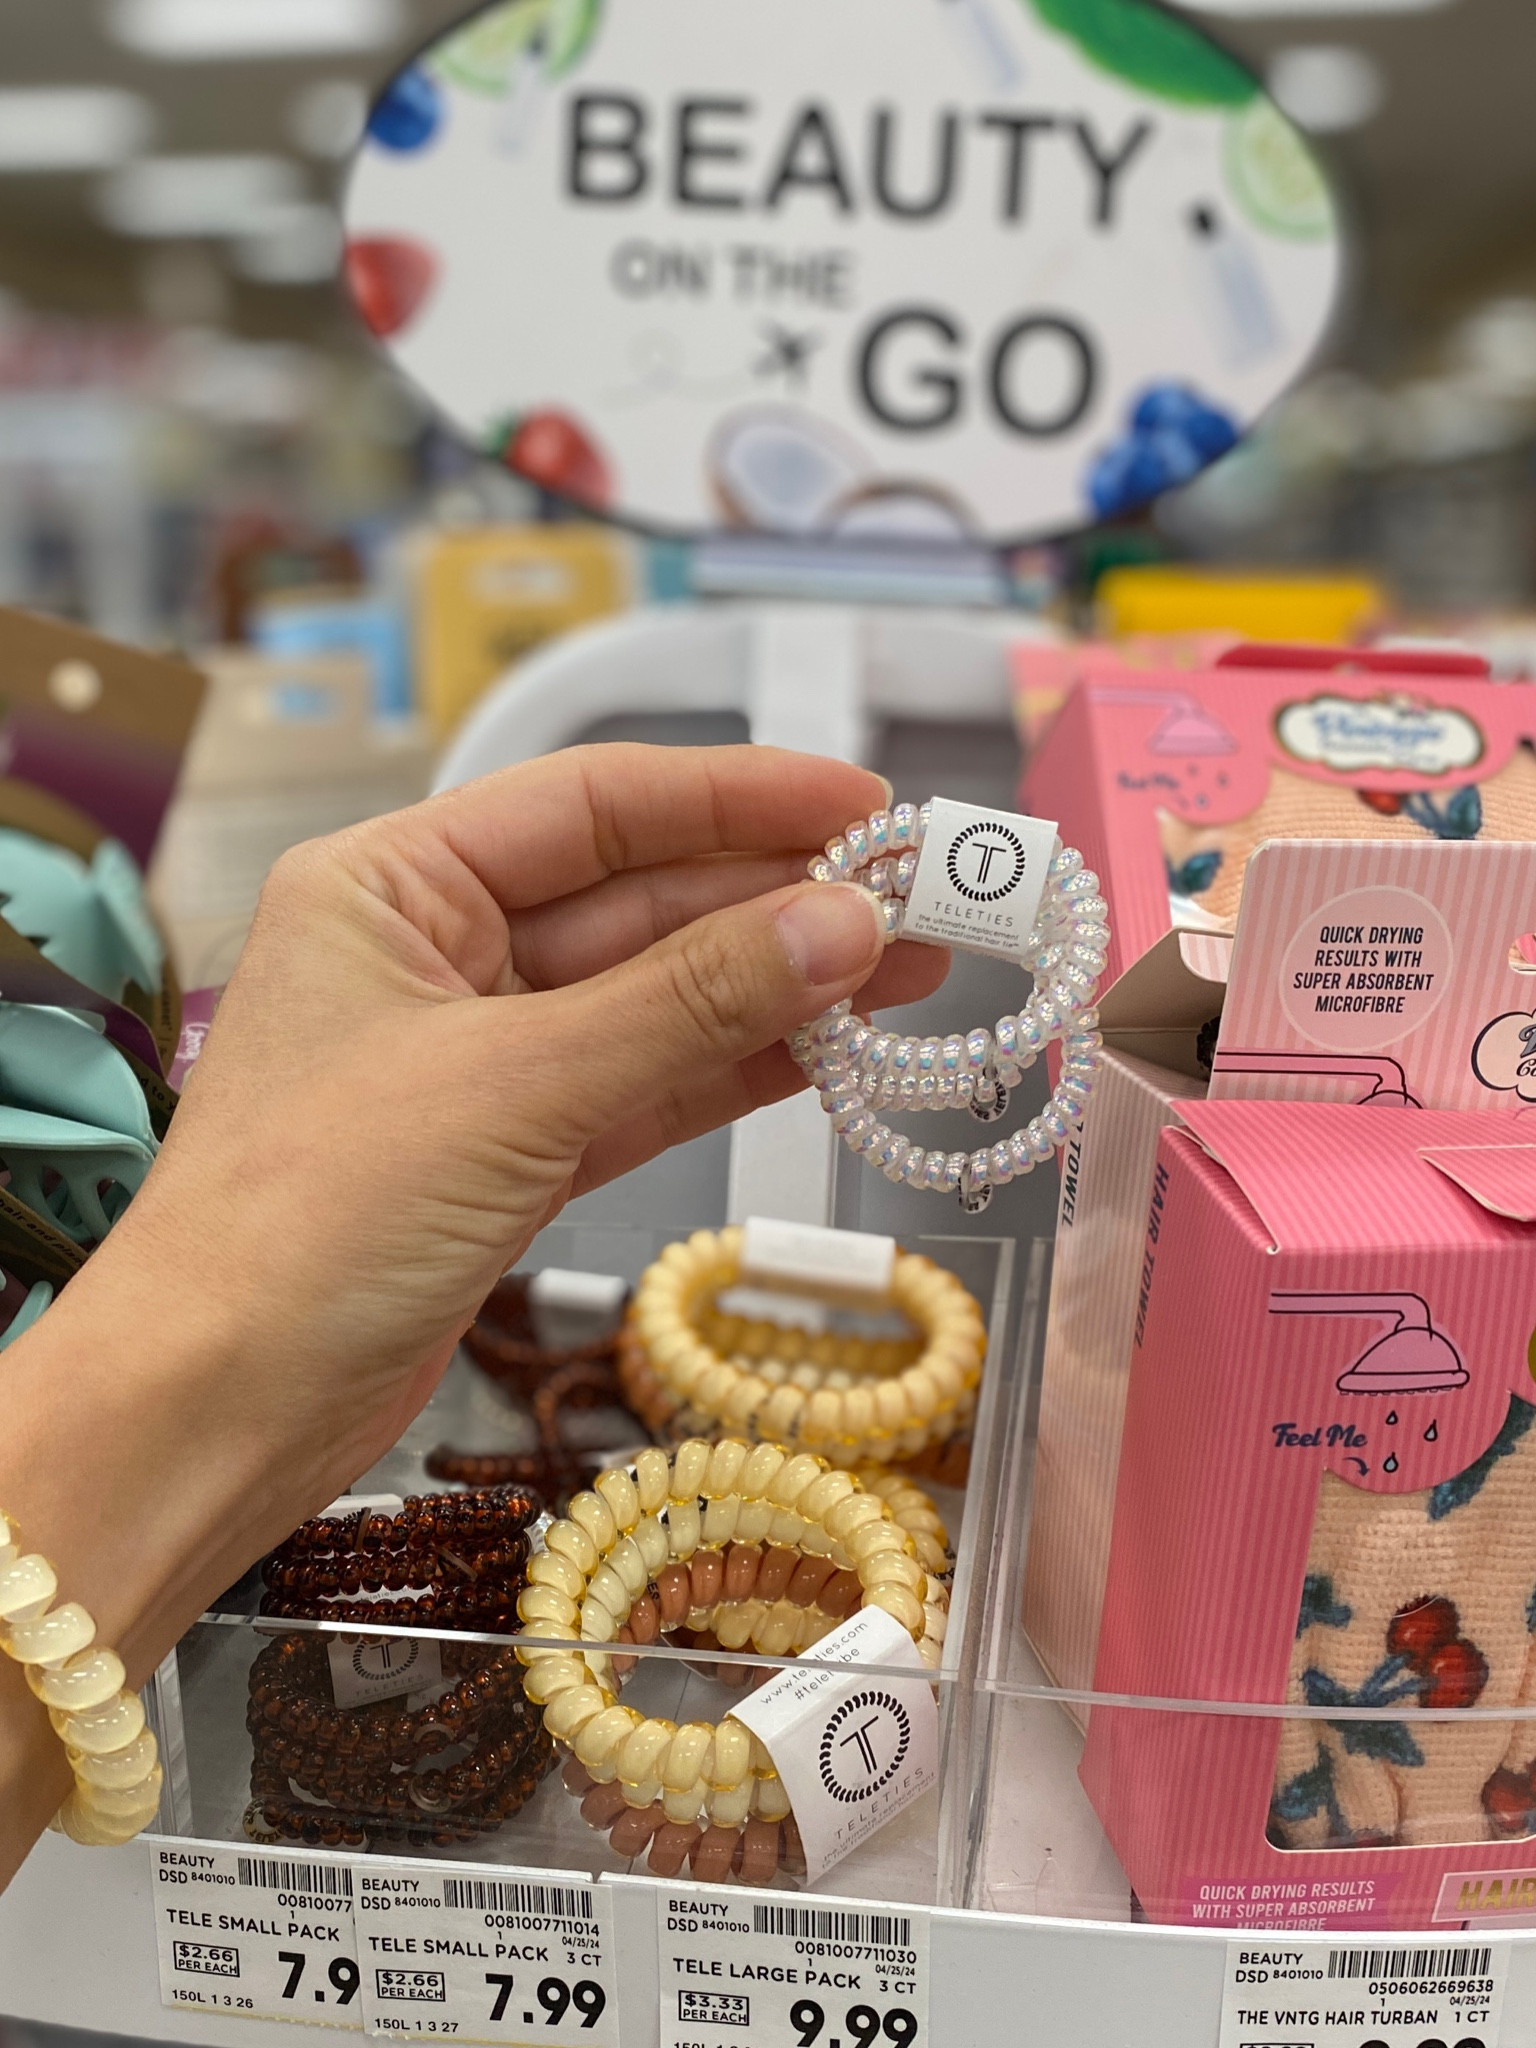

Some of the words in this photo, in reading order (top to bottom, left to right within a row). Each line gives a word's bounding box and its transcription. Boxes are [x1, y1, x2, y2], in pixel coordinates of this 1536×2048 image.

[564, 92, 1151, 226] BEAUTY
[610, 238, 711, 297] ON
[727, 243, 853, 308] THE
[856, 306, 1100, 437] GO
[934, 901, 1014, 928] TELETIES
[915, 922, 923, 930] to
[926, 924, 939, 933] the
[941, 926, 983, 943] traditional
[984, 935, 1000, 946] hair
[918, 914, 931, 924] the
[933, 916, 966, 931] ultimate
[968, 925, 1020, 941] replacement
[1320, 926, 1364, 944] QUICK
[1368, 927, 1424, 944] DRYING
[1315, 950, 1379, 967] RESULTS
[1385, 951, 1422, 968] WITH
[1293, 973, 1341, 989] SUPER
[1346, 974, 1434, 991] ABSORBENT
[1315, 996, 1405, 1013] MICROFIBRE
[1062, 1139, 1082, 1228] TOWEL
[1148, 1162, 1170, 1245] HAIR
[1134, 1251, 1156, 1349] TOWEL
[1272, 1422, 1322, 1447] Feel
[1326, 1424, 1368, 1447] Me
[835, 1767, 924, 1840] TELETIES
[160, 1852, 215, 1869] BEAUTY
[159, 1869, 187, 1884] DSD
[191, 1872, 235, 1885] 8401010
[362, 1878, 420, 1893] BEAUTY
[1200, 1884, 1246, 1900] QUICK
[1251, 1883, 1306, 1899] DRYING
[1311, 1880, 1375, 1897] RESULTS
[1457, 1878, 1536, 1911] HAIR
[361, 1896, 391, 1911] DSD
[394, 1896, 441, 1909] 8401010
[669, 1899, 729, 1917] BEAUTY
[1192, 1903, 1231, 1919] WITH
[1236, 1902, 1283, 1918] SUPER
[1288, 1898, 1376, 1916] ABSORBENT
[166, 1909, 212, 1928] TELE
[218, 1915, 281, 1936] SMALL
[288, 1923, 340, 1942] PACK
[484, 1914, 600, 1937] 0081007711014
[667, 1918, 698, 1933] DSD
[702, 1919, 750, 1934] 8401010
[561, 1935, 600, 1949] 04/25/24
[179, 1943, 233, 1962] $2.66
[368, 1936, 417, 1953] TELE
[423, 1939, 489, 1958] SMALL
[495, 1944, 549, 1962] PACK
[566, 1952, 576, 1964] 3
[581, 1954, 602, 1967] CT
[794, 1940, 917, 1964] 0081007711030
[1239, 1952, 1303, 1965] BEAUTY
[178, 1959, 201, 1970] PER
[204, 1963, 237, 1975] EACH
[673, 1958, 723, 1976] TELE
[730, 1963, 798, 1984] LARGE
[805, 1970, 861, 1990] PACK
[879, 1980, 889, 1993] 3
[894, 1981, 917, 1994] CT
[875, 1964, 916, 1977] 04/25/24
[1235, 1970, 1268, 1983] DSD
[1273, 1969, 1323, 1980] 8401010
[382, 1971, 439, 1987] $2.66
[1368, 1980, 1494, 1995] 0506062669638
[172, 1989, 206, 2003] 150L
[211, 1993, 217, 2004] 1
[223, 1995, 232, 2006] 3
[236, 1997, 254, 2008] 26
[381, 1986, 405, 1998] PER
[409, 1988, 443, 1999] EACH
[485, 1972, 606, 2028] 7.99
[1449, 1995, 1490, 2007] 04/25/24
[684, 1993, 744, 2011] $3.33
[683, 2008, 708, 2020] PER
[711, 2011, 747, 2023] EACH
[789, 1999, 918, 2048] 9.99
[1237, 2010, 1269, 2025] THE
[1274, 2010, 1320, 2025] VNTG
[1325, 2010, 1365, 2025] HAIR
[1370, 2010, 1438, 2025] TURBAN
[1455, 2011, 1460, 2023] 1
[1467, 2010, 1490, 2023] CT
[374, 2018, 410, 2031] 150L
[415, 2020, 422, 2031] 1
[428, 2021, 437, 2032] 3
[442, 2022, 459, 2033] 27
